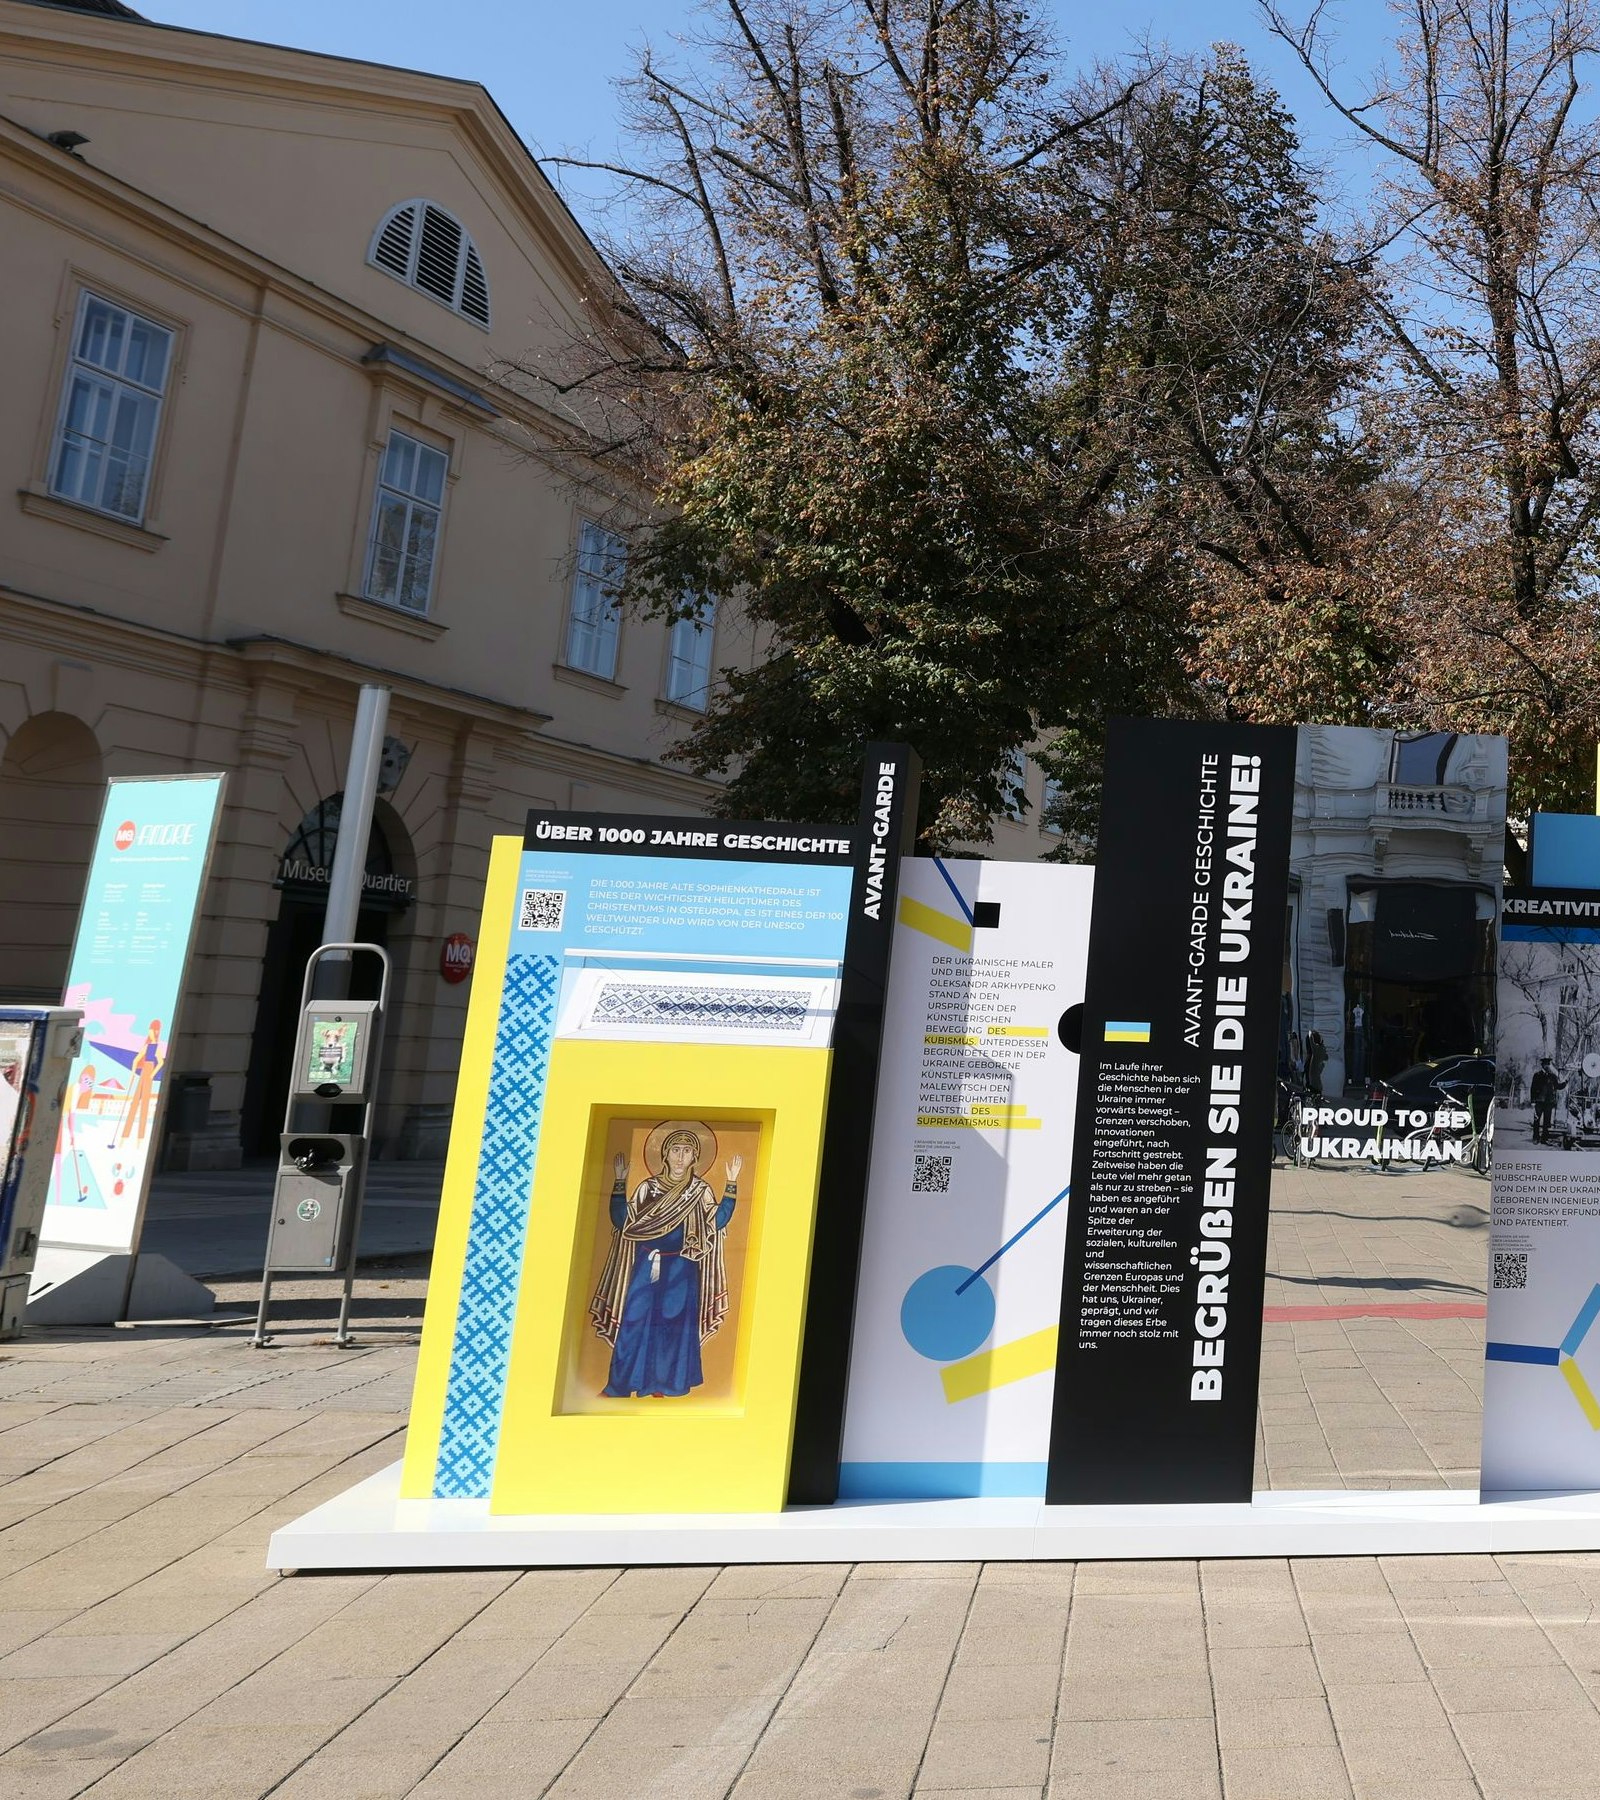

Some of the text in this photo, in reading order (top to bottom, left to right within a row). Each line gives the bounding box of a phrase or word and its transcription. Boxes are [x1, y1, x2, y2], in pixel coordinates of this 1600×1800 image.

[536, 821, 850, 853] ÜBER 1000 JAHRE GESCHICHTE
[864, 763, 895, 920] AVANT-GARDE
[1219, 755, 1261, 962] UKRAINE!
[1184, 754, 1218, 1047] AVANT-GARDE GESCHICHTE
[932, 956, 1054, 969] DER UKRAINISCHE MALER
[931, 968, 1011, 978] UND BILDHAUER
[929, 978, 1056, 991] OLEKSANDR ARKHYPENKO
[928, 990, 1000, 1000] STAND AN DEN
[927, 1001, 1017, 1012] URSPRUNGEN DER
[926, 1013, 1011, 1023] KÜNSTLERISCHEN
[1214, 977, 1247, 1050] DIE
[925, 1024, 1007, 1035] BEWEGUNG DES
[979, 1038, 1049, 1048] UNTERDESSEN
[923, 1047, 1046, 1059] BEGRÜNDETE DER IN DER
[922, 1059, 1020, 1070] UKRAINE GEBORENE
[1099, 1061, 1163, 1071] Im Laufe ihrer
[921, 1070, 1013, 1081] KÜNSTLER KASIMIR
[1098, 1072, 1201, 1083] Geschichte haben sich
[919, 1082, 1010, 1092] MALEWYTSCH DEN
[1097, 1083, 1190, 1094] die Menschen in der
[1097, 1094, 1133, 1103] Ukraine
[1208, 1065, 1242, 1134] SIE
[917, 1105, 990, 1115] KUNSTSTIL DES
[1095, 1105, 1136, 1114] vorwärts
[1137, 1106, 1172, 1117] bewegt
[916, 1116, 1001, 1127] SUPREMATISMUS.
[1095, 1116, 1191, 1128] Grenzen verschoben,
[1302, 1108, 1467, 1128] PROUD TO BE
[1094, 1127, 1155, 1137] Innovationen
[1093, 1138, 1170, 1149] eingeführt, nach
[1300, 1137, 1462, 1160] UKRAINIAN
[1495, 1161, 1542, 1171] DER ERSTE
[1494, 1173, 1568, 1182] HUBSCHRAUBER
[1493, 1184, 1513, 1192] VON
[1515, 1185, 1536, 1193] DEM
[1537, 1185, 1547, 1193] IN
[1549, 1185, 1568, 1193] DER
[1493, 1195, 1599, 1205] GEBORENEN INGENIEUR
[1493, 1207, 1515, 1215] IGOR
[1517, 1207, 1560, 1216] SIKORSKY
[1493, 1218, 1513, 1226] UND
